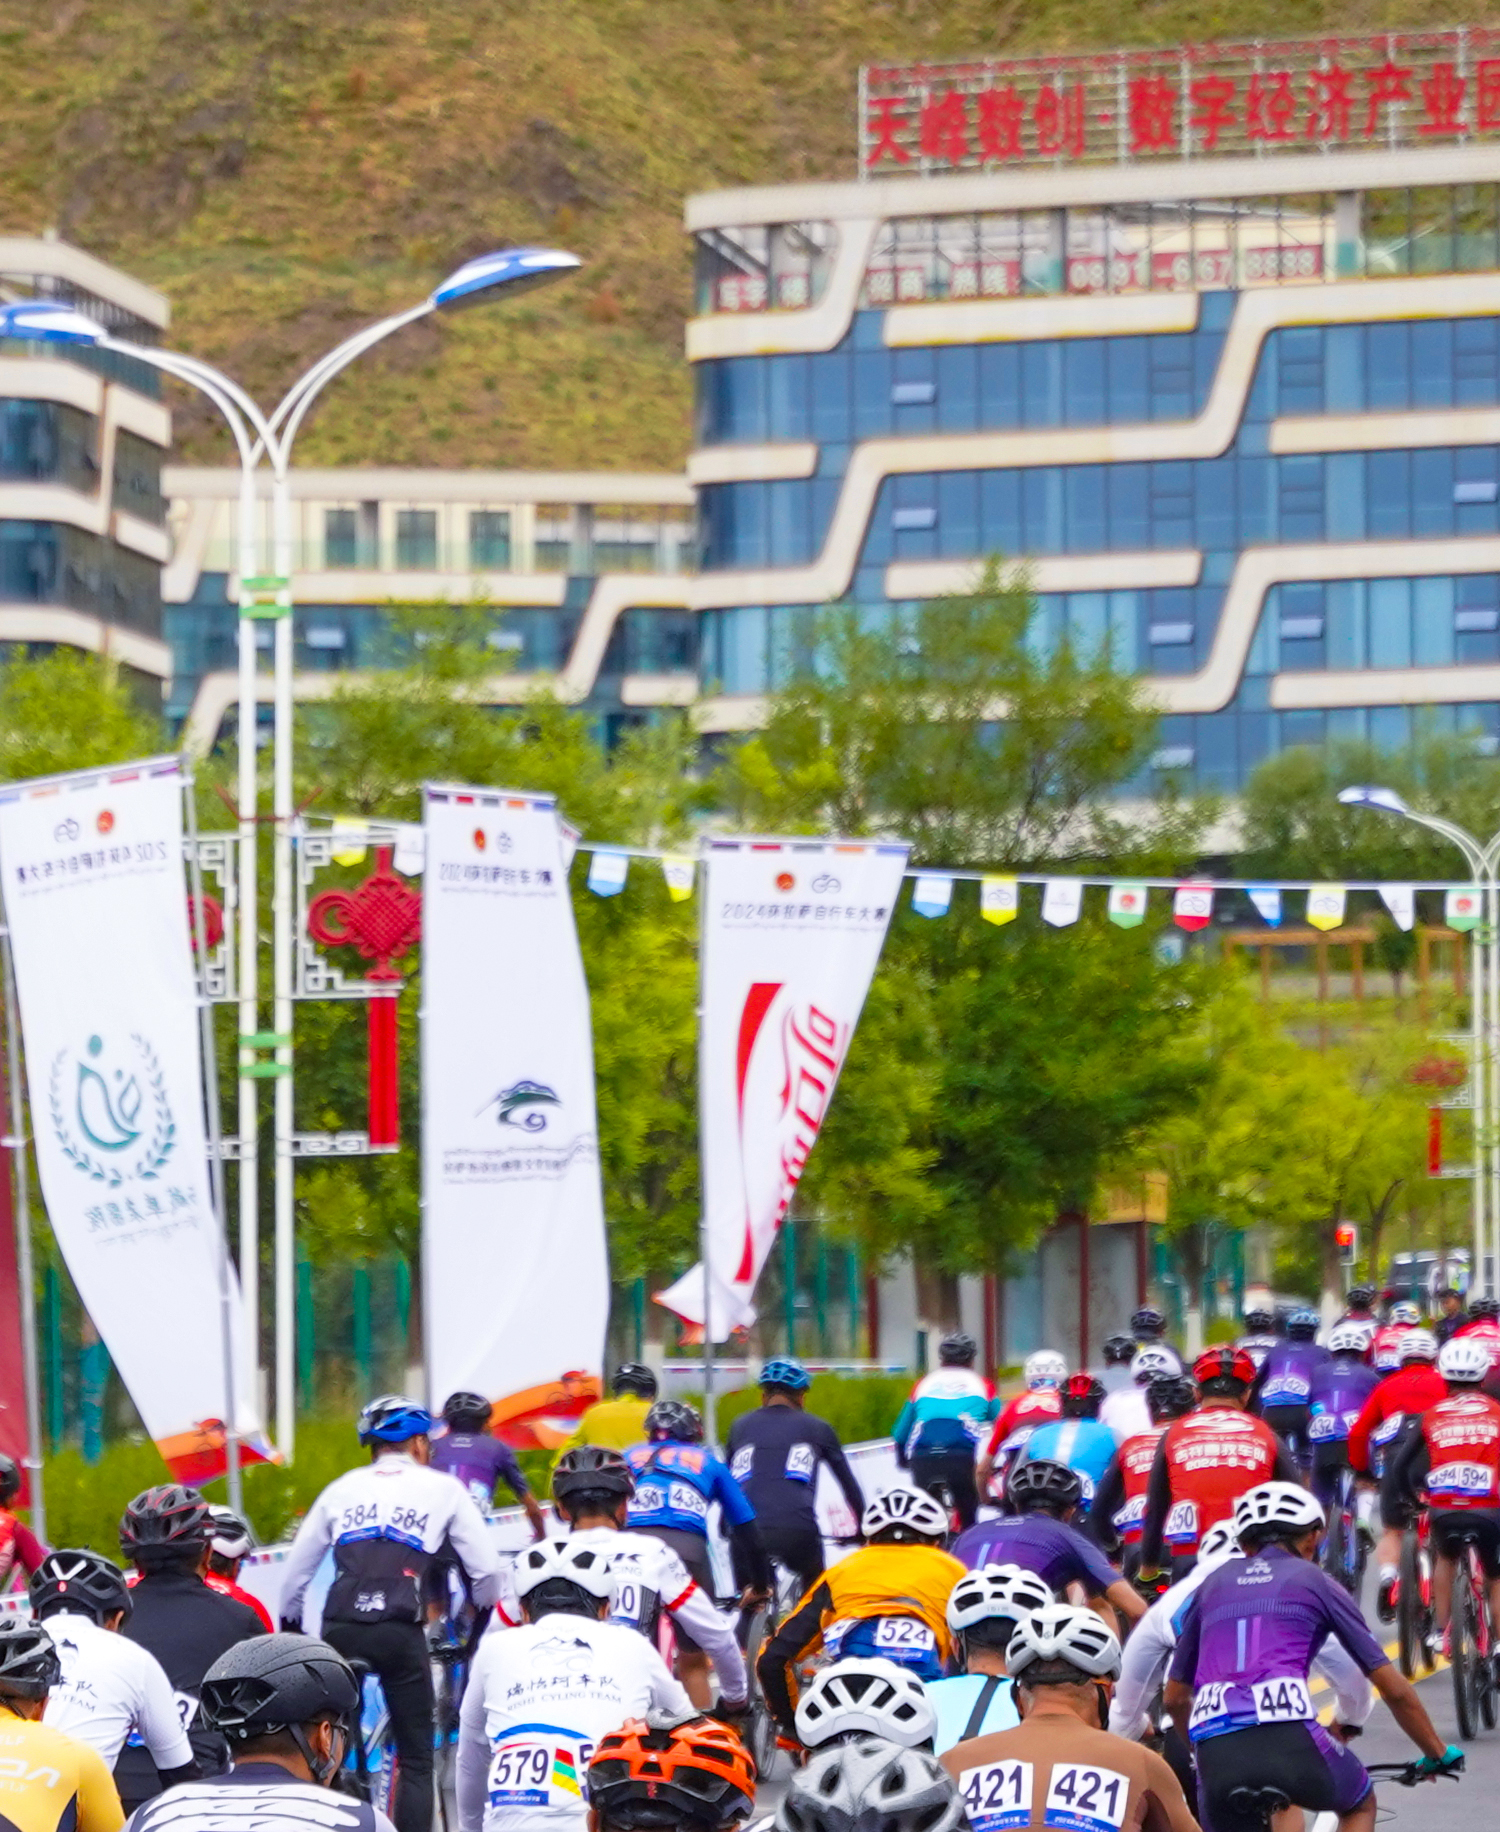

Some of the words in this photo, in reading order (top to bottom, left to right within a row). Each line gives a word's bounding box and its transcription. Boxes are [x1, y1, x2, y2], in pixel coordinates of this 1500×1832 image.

[1460, 1465, 1489, 1488] 594
[341, 1505, 380, 1529] 584
[390, 1507, 431, 1533] 584
[880, 1620, 929, 1645] 524
[590, 1691, 622, 1704] TEAM
[1260, 1681, 1307, 1719] 443
[493, 1748, 549, 1786] 579
[964, 1764, 1023, 1813] 421
[1053, 1768, 1120, 1819] 421
